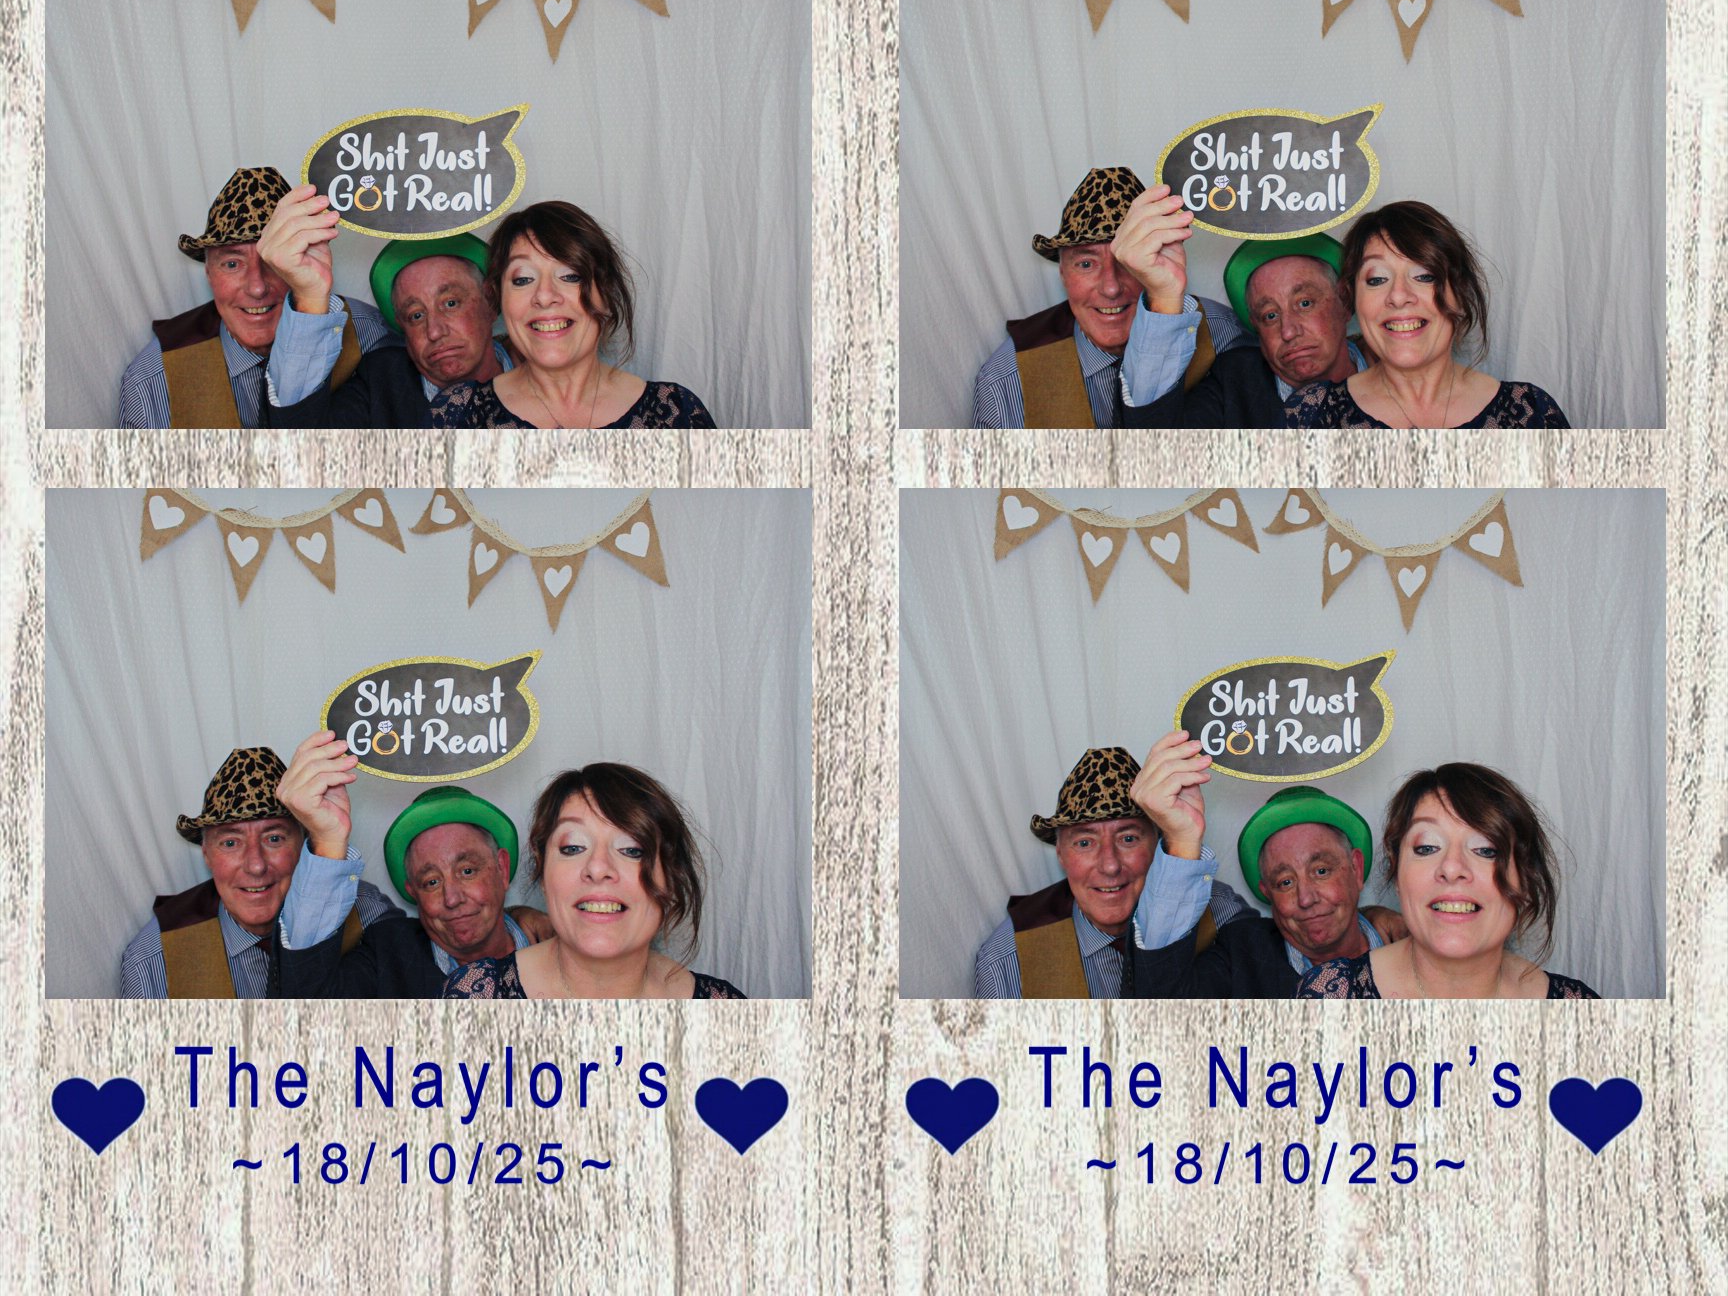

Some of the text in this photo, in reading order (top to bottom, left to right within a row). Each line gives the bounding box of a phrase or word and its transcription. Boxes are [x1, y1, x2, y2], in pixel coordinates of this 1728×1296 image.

[337, 131, 491, 171] Shit Just
[1191, 131, 1345, 171] Shit Just
[328, 174, 492, 212] Got Real!
[1182, 174, 1346, 212] Got Real!
[355, 676, 505, 717] Shit Just
[1209, 676, 1359, 717] Shit Just
[347, 717, 508, 756] Got Real!
[1201, 717, 1362, 756] Got Real!
